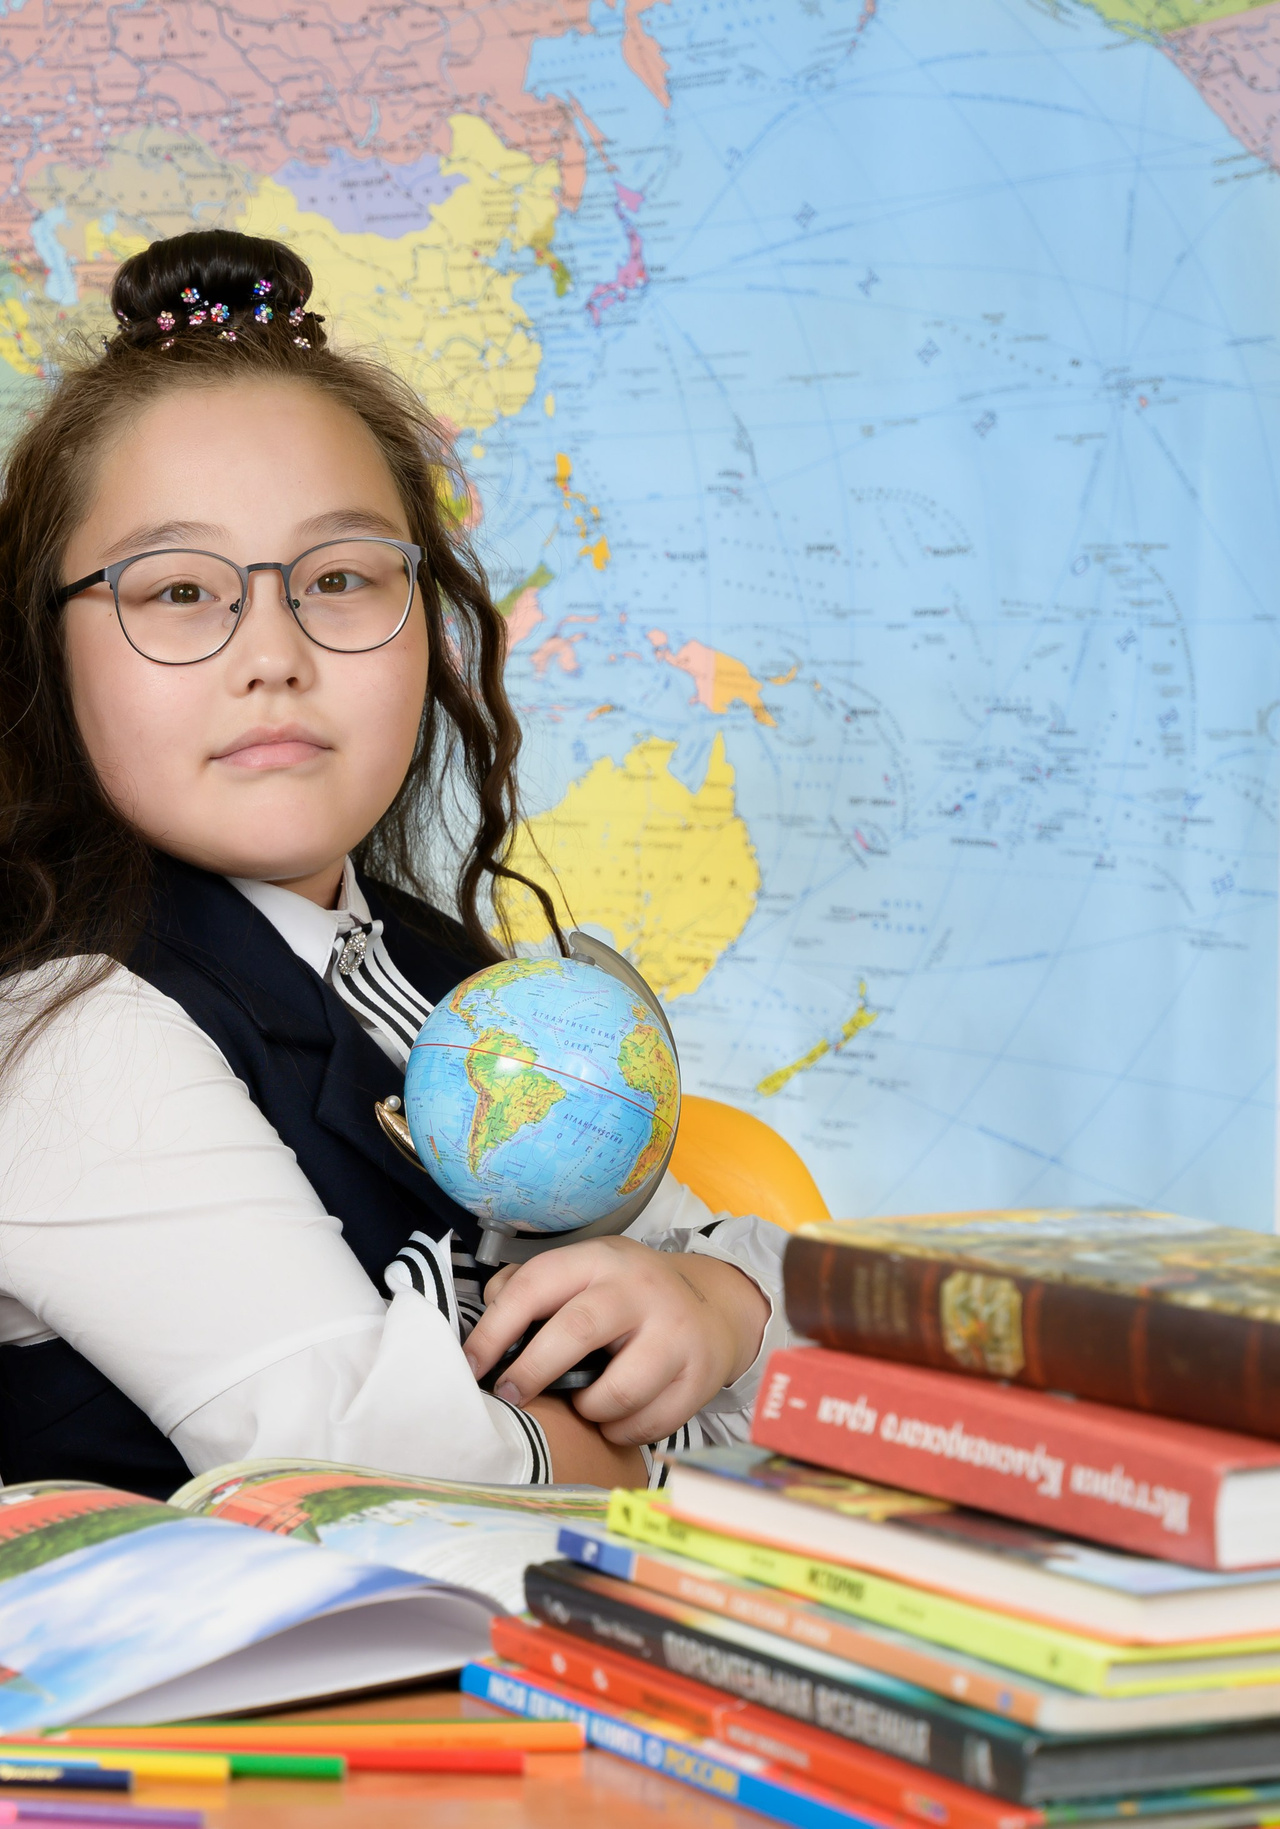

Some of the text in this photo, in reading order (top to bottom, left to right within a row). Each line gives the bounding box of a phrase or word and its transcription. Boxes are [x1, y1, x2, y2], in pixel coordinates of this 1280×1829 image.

[532, 1010, 616, 1041] АТЛАНТИЧЕСКИЙ
[564, 1039, 594, 1054] ОКЕАН
[563, 1113, 624, 1145] АТЛАНТИЧЕСКИЙ
[556, 1132, 616, 1164] ОКЕАН
[816, 1393, 1191, 1535] История Красноярского края
[814, 1683, 931, 1765] ВСЕЛЕННАЯ
